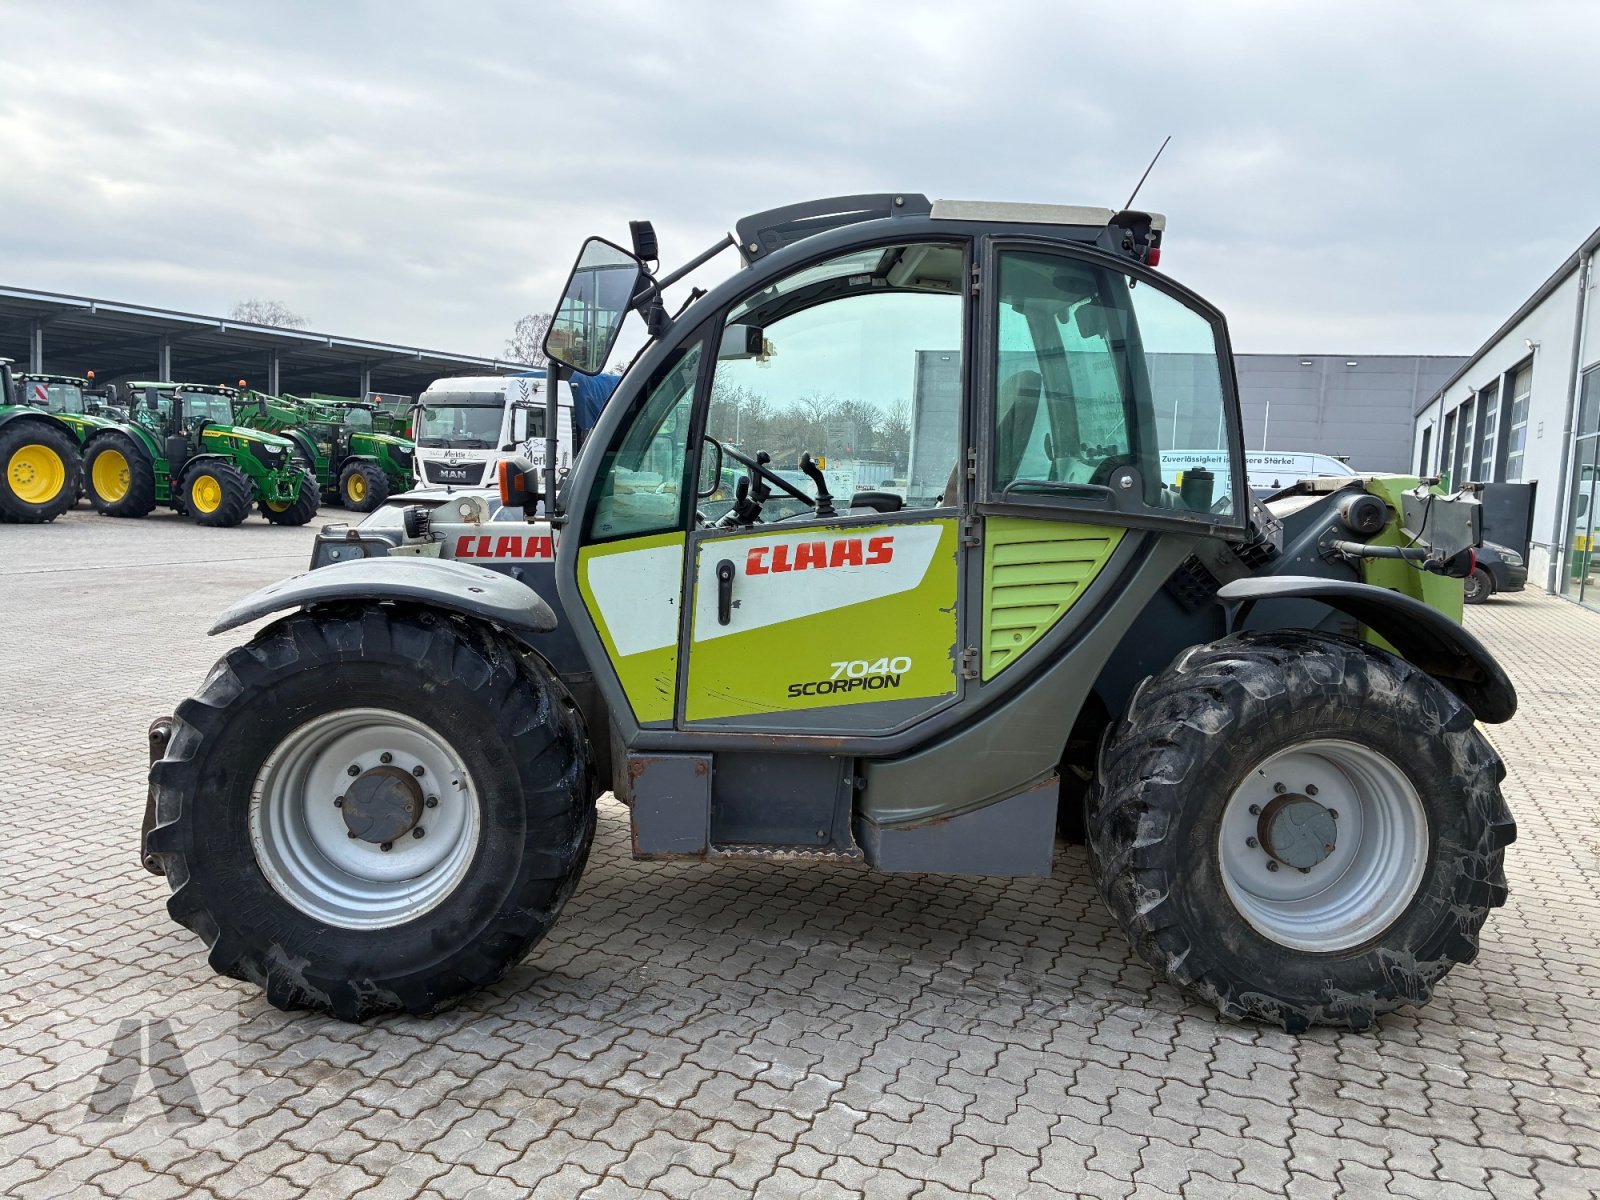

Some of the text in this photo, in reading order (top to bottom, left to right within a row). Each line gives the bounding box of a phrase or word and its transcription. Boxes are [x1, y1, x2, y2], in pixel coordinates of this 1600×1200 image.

[1162, 455, 1222, 464] Zuverlässigkeit
[1264, 457, 1295, 465] Stärke!
[440, 470, 467, 479] MAN
[454, 535, 557, 558] CLAA
[745, 536, 895, 576] CLAAS
[830, 656, 912, 680] 7040
[787, 674, 901, 698] SCORPION
